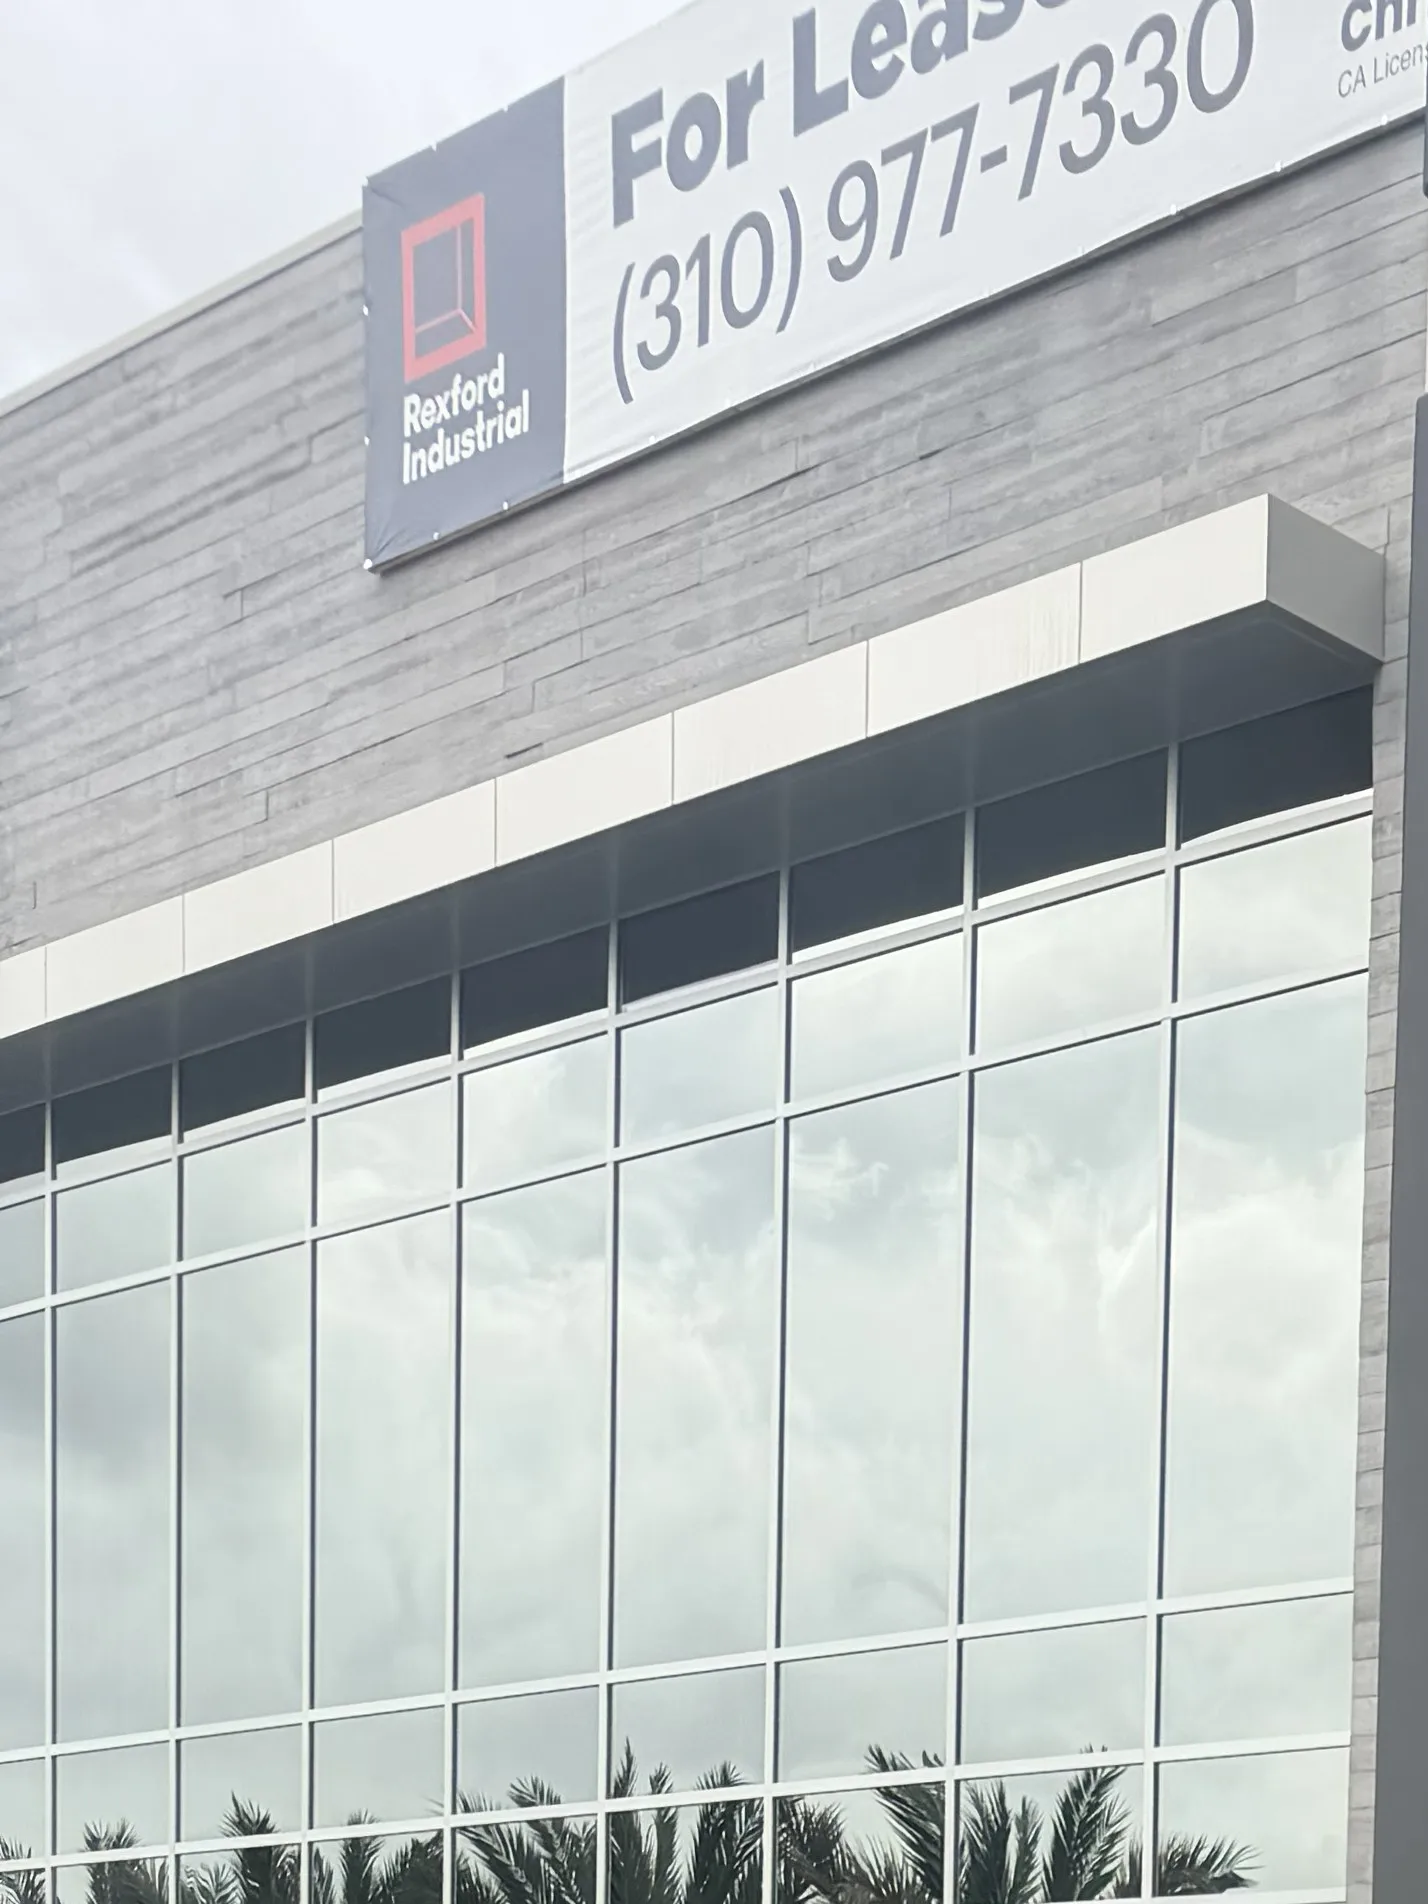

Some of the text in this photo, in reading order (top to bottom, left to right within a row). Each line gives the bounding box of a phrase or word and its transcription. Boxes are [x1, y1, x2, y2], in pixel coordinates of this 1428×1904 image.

[1338, 64, 1366, 98] CA
[611, 59, 765, 229] For
[613, 0, 1254, 404] (310) 977-7330
[403, 388, 529, 485] Industrial
[404, 352, 505, 438] Rexford
